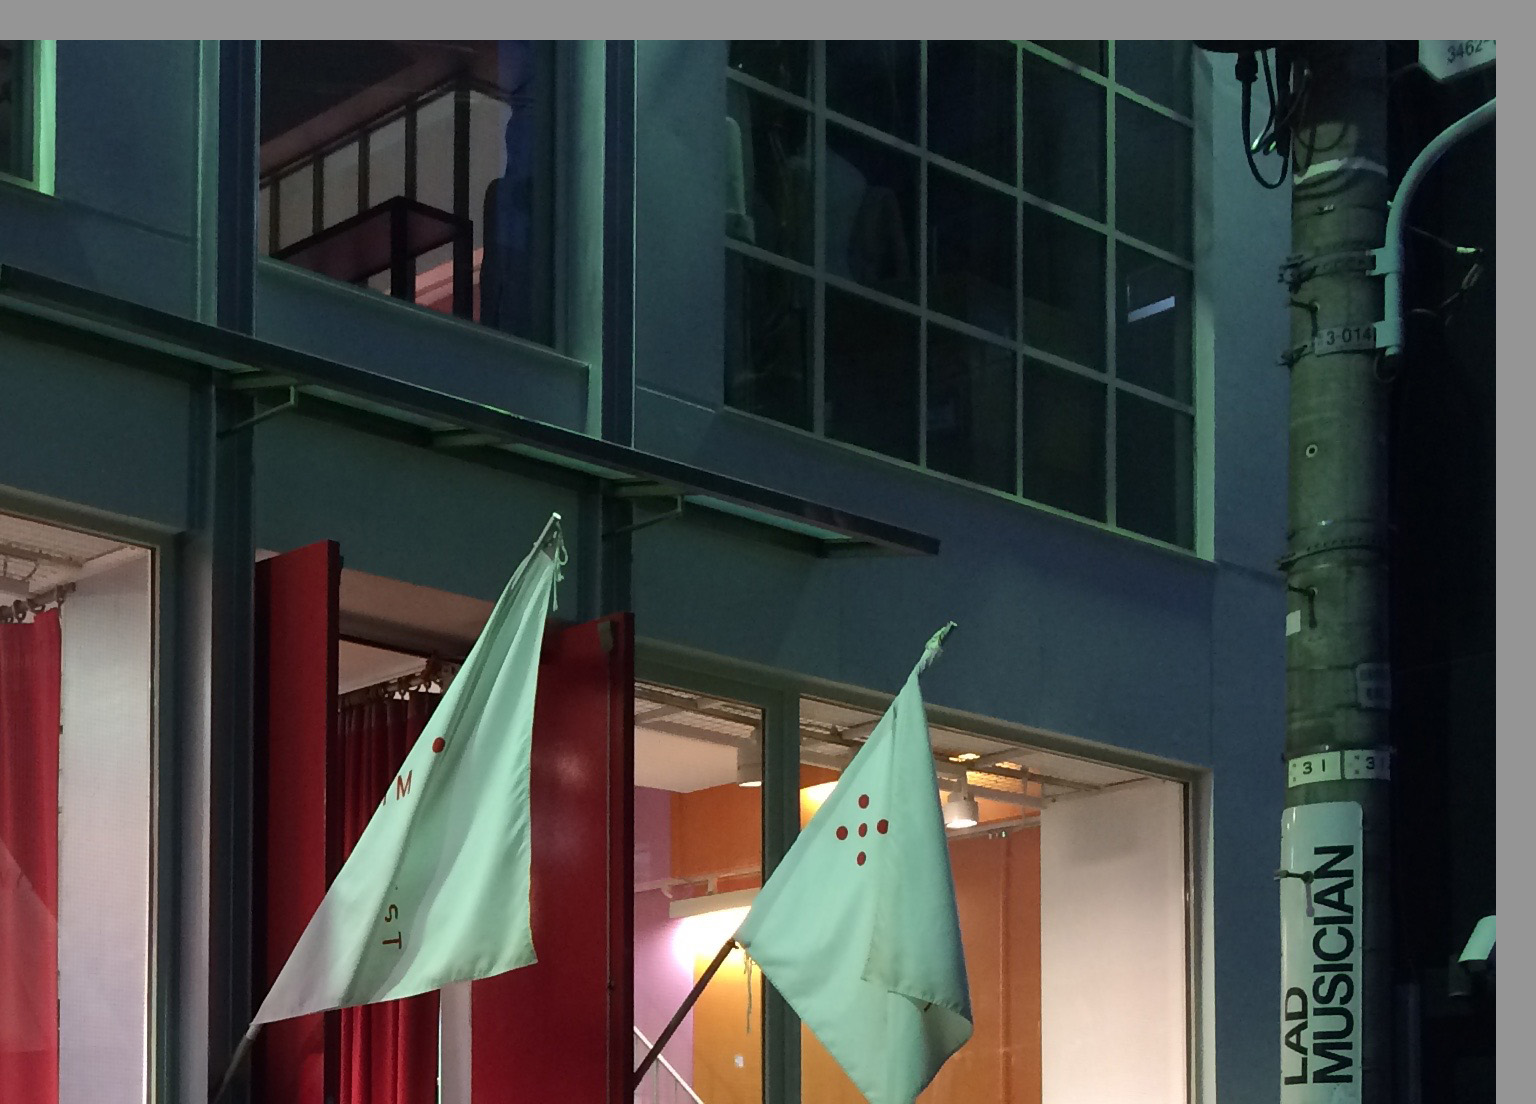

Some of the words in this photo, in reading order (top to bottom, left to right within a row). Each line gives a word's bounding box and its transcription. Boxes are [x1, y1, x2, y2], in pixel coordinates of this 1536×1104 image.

[1302, 758, 1326, 775] 31
[1312, 845, 1355, 1085] MUSICIAN
[1284, 986, 1308, 1085] LAD
